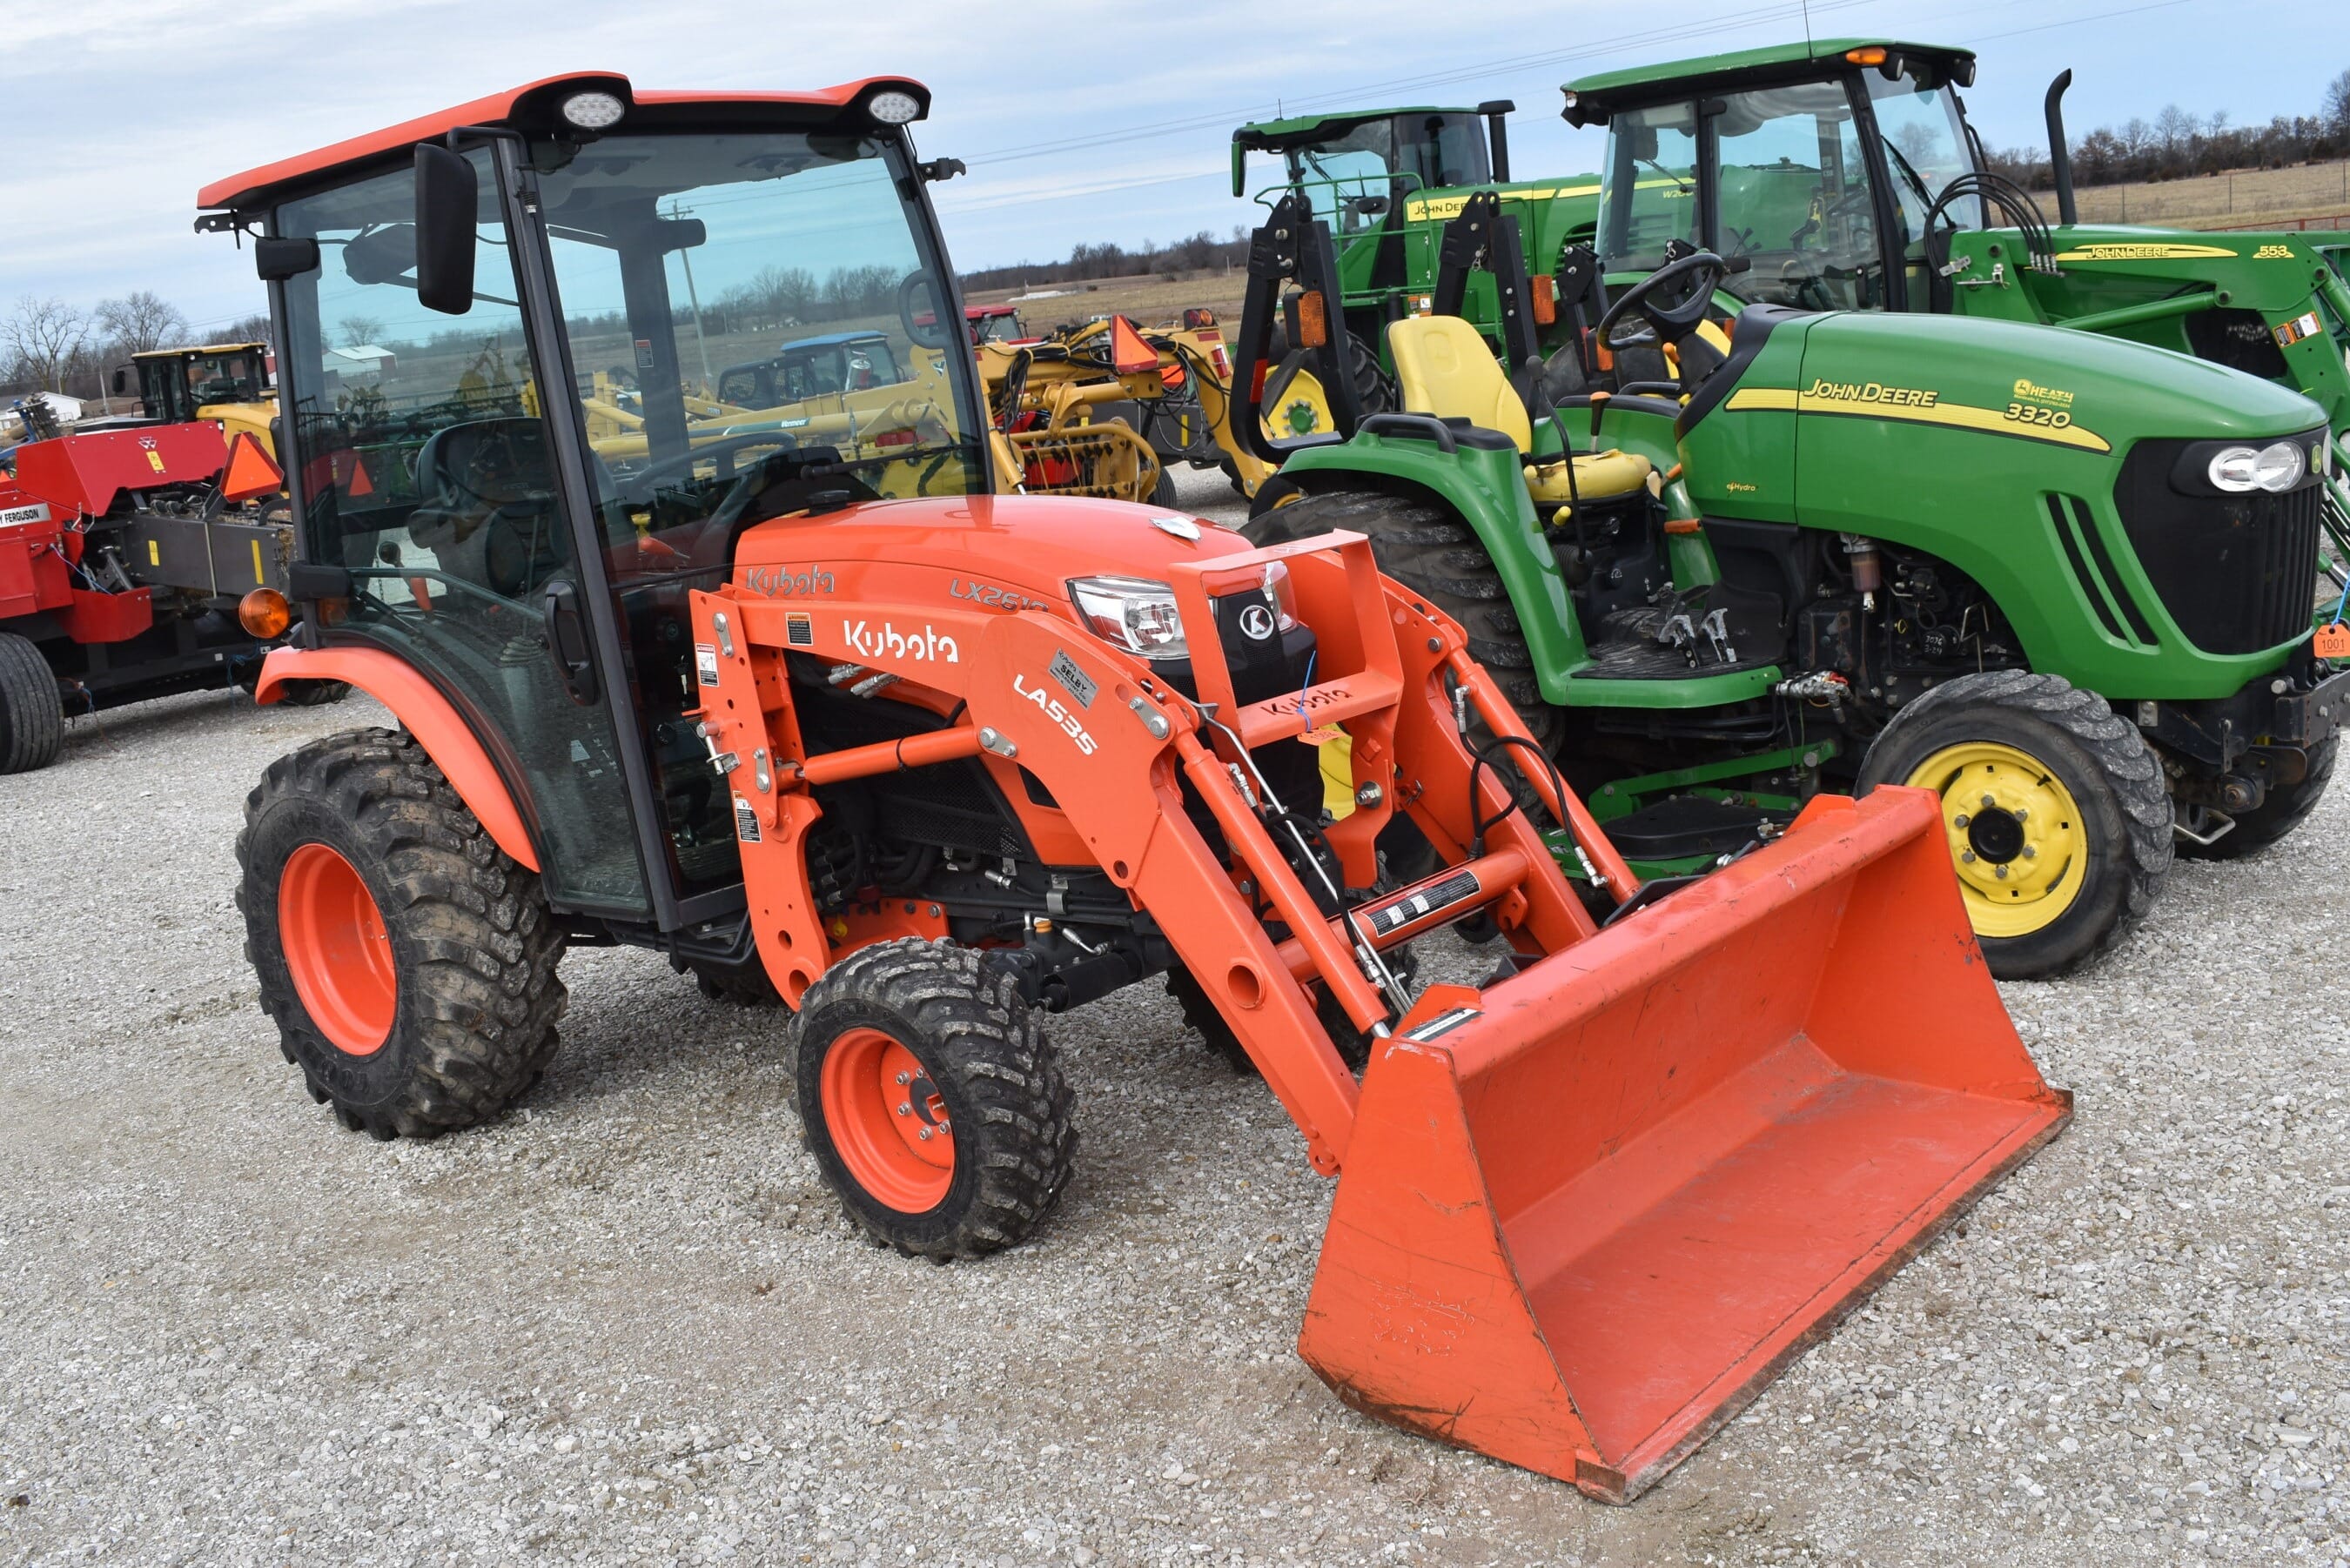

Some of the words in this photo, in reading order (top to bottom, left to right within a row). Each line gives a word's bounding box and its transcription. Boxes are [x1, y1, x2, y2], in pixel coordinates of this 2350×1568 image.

[2086, 247, 2124, 258] JOHN
[2125, 246, 2170, 258] DEERE
[2259, 245, 2287, 258] 553
[1803, 378, 1862, 400] JOHN
[1860, 382, 1938, 407] DEERE
[2030, 385, 2075, 403] HEATH
[2004, 402, 2071, 429] 3320
[4, 508, 40, 524] FERGUSON
[746, 564, 835, 596] Kubota
[843, 620, 959, 663] Kubota
[2322, 639, 2345, 650] 1001
[1061, 664, 1087, 690] SELBY
[1013, 673, 1098, 755] LA535
[1260, 690, 1353, 715] Kubota
